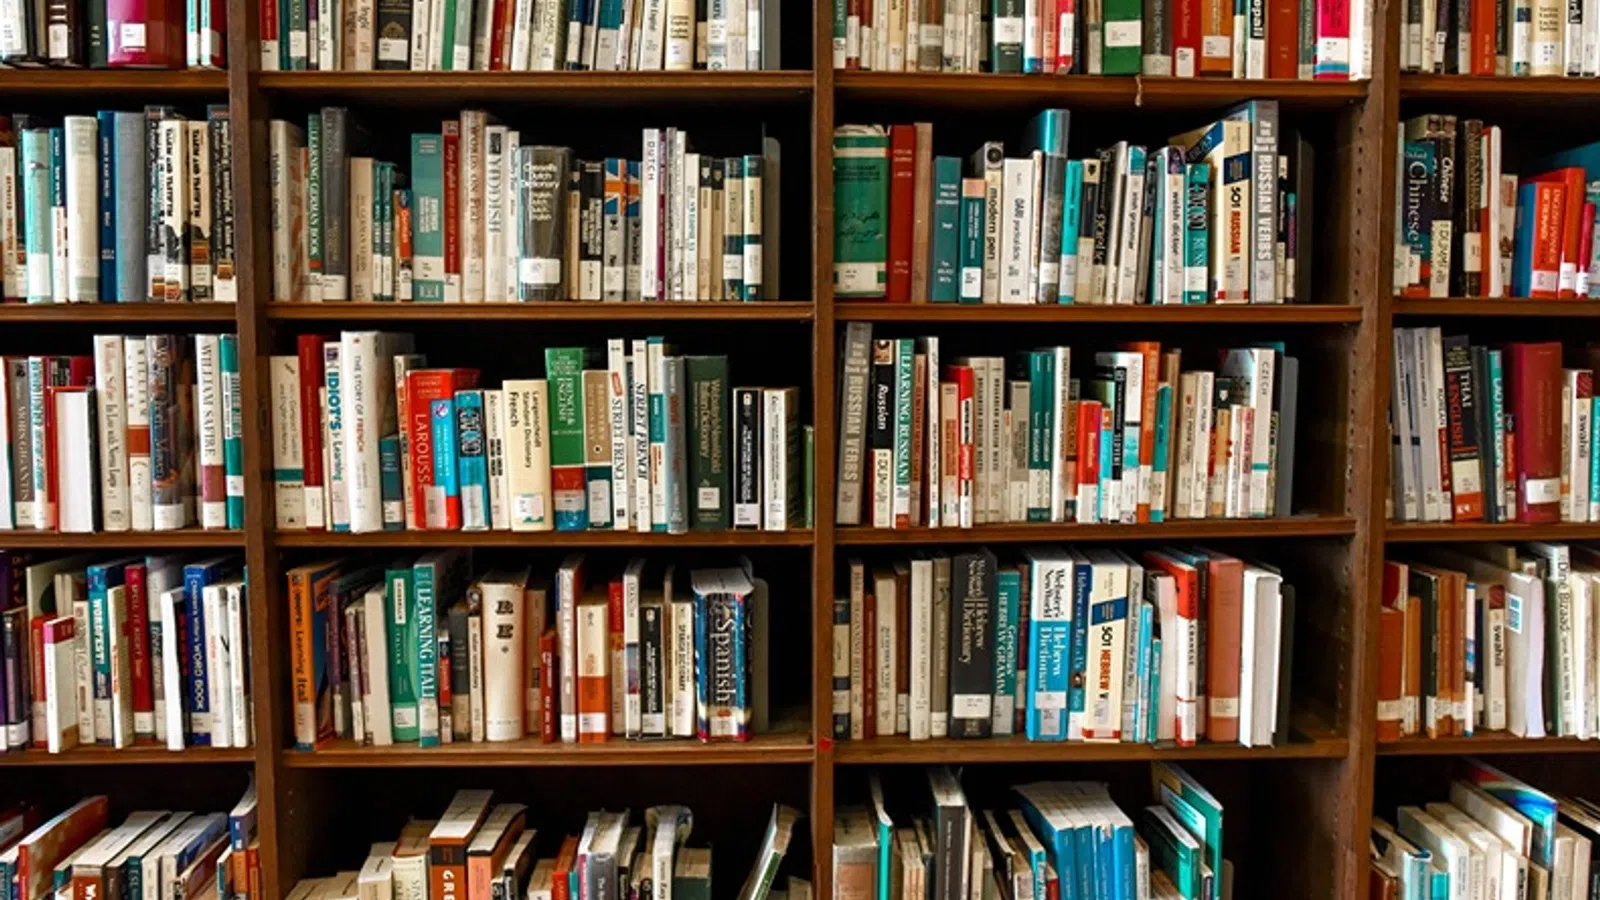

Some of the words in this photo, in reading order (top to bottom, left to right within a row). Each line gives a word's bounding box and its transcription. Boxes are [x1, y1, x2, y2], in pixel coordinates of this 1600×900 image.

[310, 130, 320, 182] LEARNING
[488, 157, 501, 234] YIDDISH
[1230, 186, 1241, 208] 501
[1258, 154, 1274, 214] RUSSIAN
[1407, 161, 1427, 241] Chinese
[1440, 156, 1453, 203] Chinese
[310, 183, 320, 227] GERMAN
[989, 187, 999, 233] modern
[1014, 198, 1024, 218] DARI
[1171, 191, 1180, 220] welsh
[310, 228, 320, 255] BOOK
[1129, 211, 1139, 250] grammar
[1230, 210, 1240, 254] RUSSIAN
[1256, 217, 1272, 261] VERBS
[137, 349, 147, 417] WILLIAM
[201, 344, 213, 405] WILLIAM
[354, 355, 362, 371] THE
[328, 371, 342, 431] IDIOT'S
[355, 374, 363, 402] STORY
[356, 403, 364, 415] OF
[523, 391, 531, 427] Standard
[636, 382, 646, 429] STREET
[845, 375, 864, 434] RUSSIAN
[878, 385, 888, 430] Russian
[900, 354, 911, 421] LEARNING
[1438, 387, 1447, 426] KOREAN
[1460, 372, 1472, 408] THAI
[1493, 377, 1502, 402] LAO
[509, 392, 519, 428] French
[532, 391, 541, 448] Langenscheidt
[612, 398, 623, 439] STREET
[1494, 403, 1503, 427] FOR
[203, 409, 216, 458] SAFIRE
[356, 417, 365, 454] FRENCH
[524, 428, 533, 468] Dictionary
[898, 424, 909, 479] RUSSIAN
[1579, 414, 1588, 459] swahili
[332, 440, 343, 482] Learning
[637, 432, 647, 480] FRENCH
[844, 438, 860, 482] VERBS
[190, 580, 198, 616] Children's
[1044, 569, 1054, 588] New
[1054, 569, 1065, 618] Webster's
[418, 587, 433, 659] LEARNING
[998, 592, 1008, 643] HEBREW
[1044, 589, 1054, 618] World
[676, 625, 684, 652] SPANISH
[959, 602, 976, 664] Dictionary
[975, 602, 988, 650] Hebrew
[1101, 625, 1112, 646] 501
[1494, 624, 1504, 667] swahili
[193, 644, 202, 676] WORD
[296, 630, 304, 674] Learning
[676, 653, 684, 692] DICTIONARY
[710, 618, 737, 702] Spanish
[1052, 627, 1066, 676] Hebrew
[1099, 649, 1111, 691] HEBREW
[195, 679, 203, 711] BOOK
